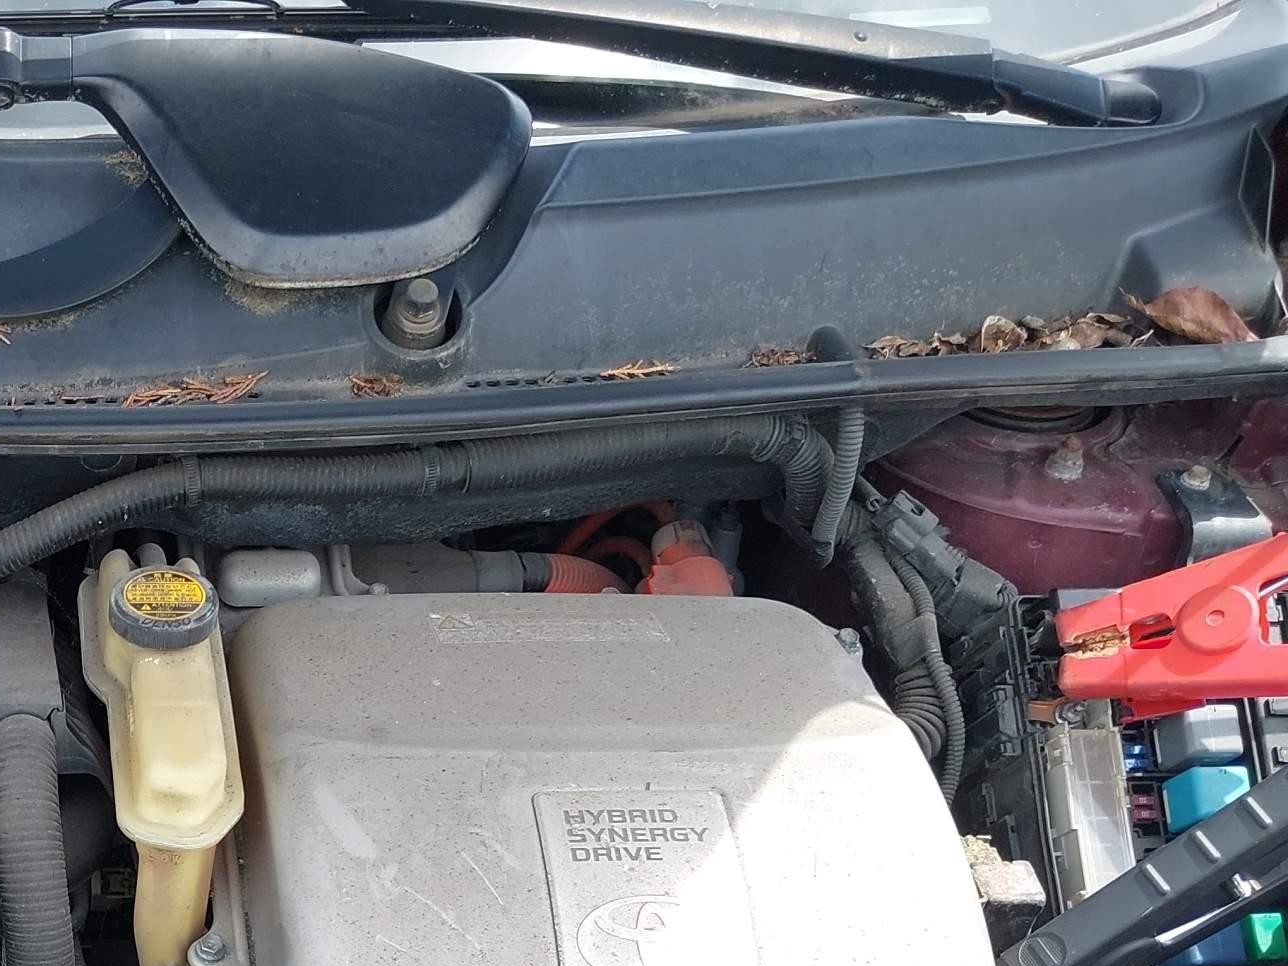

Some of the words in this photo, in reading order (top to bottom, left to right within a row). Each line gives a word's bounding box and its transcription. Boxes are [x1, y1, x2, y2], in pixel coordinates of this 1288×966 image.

[563, 809, 678, 825] HYBRID
[566, 827, 708, 843] SYNERGY
[570, 847, 663, 862] DRIVE
